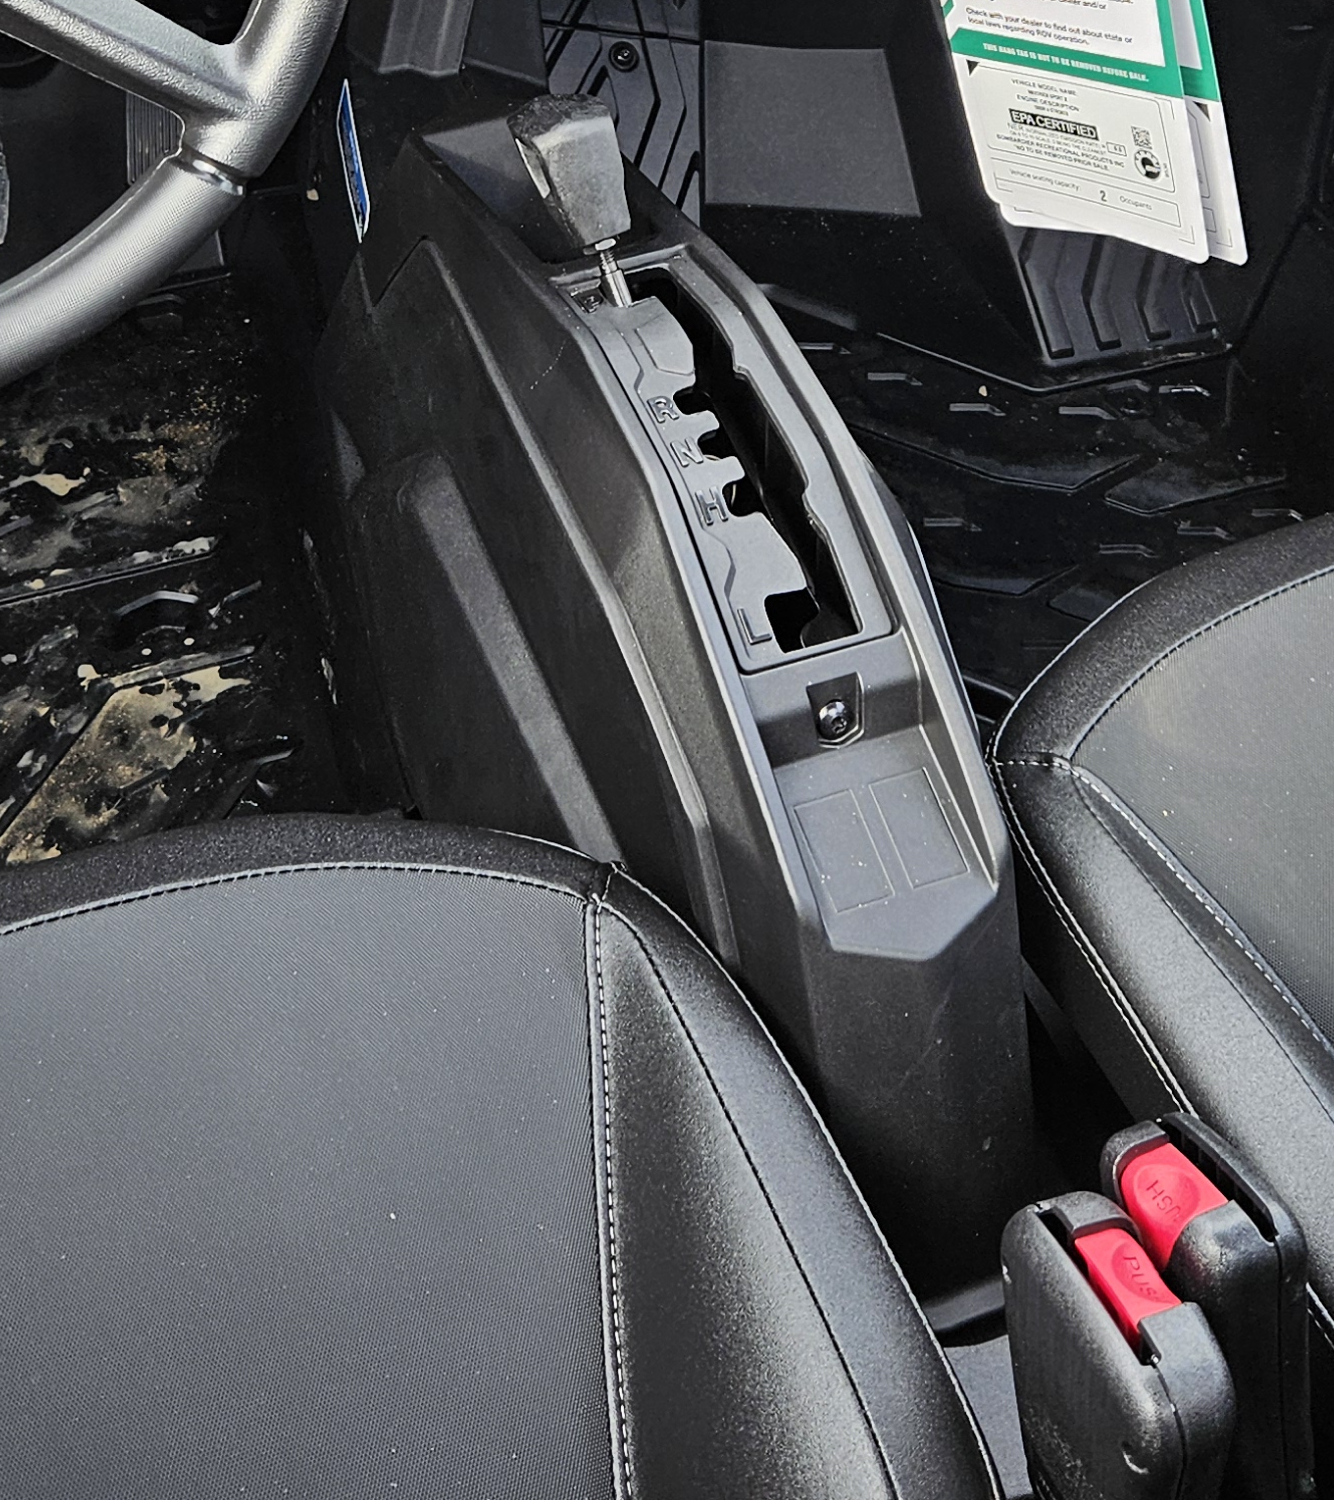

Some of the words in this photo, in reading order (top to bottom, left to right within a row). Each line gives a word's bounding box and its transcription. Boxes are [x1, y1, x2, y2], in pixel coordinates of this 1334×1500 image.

[1011, 110, 1035, 125] EPA
[1036, 115, 1096, 138] CERTIFIED
[1099, 189, 1107, 202] 2
[1119, 195, 1152, 211] Occupants
[647, 396, 679, 423] R
[670, 437, 704, 467] N
[694, 486, 728, 526] H
[737, 608, 772, 645] L
[1123, 1256, 1161, 1299] PUS
